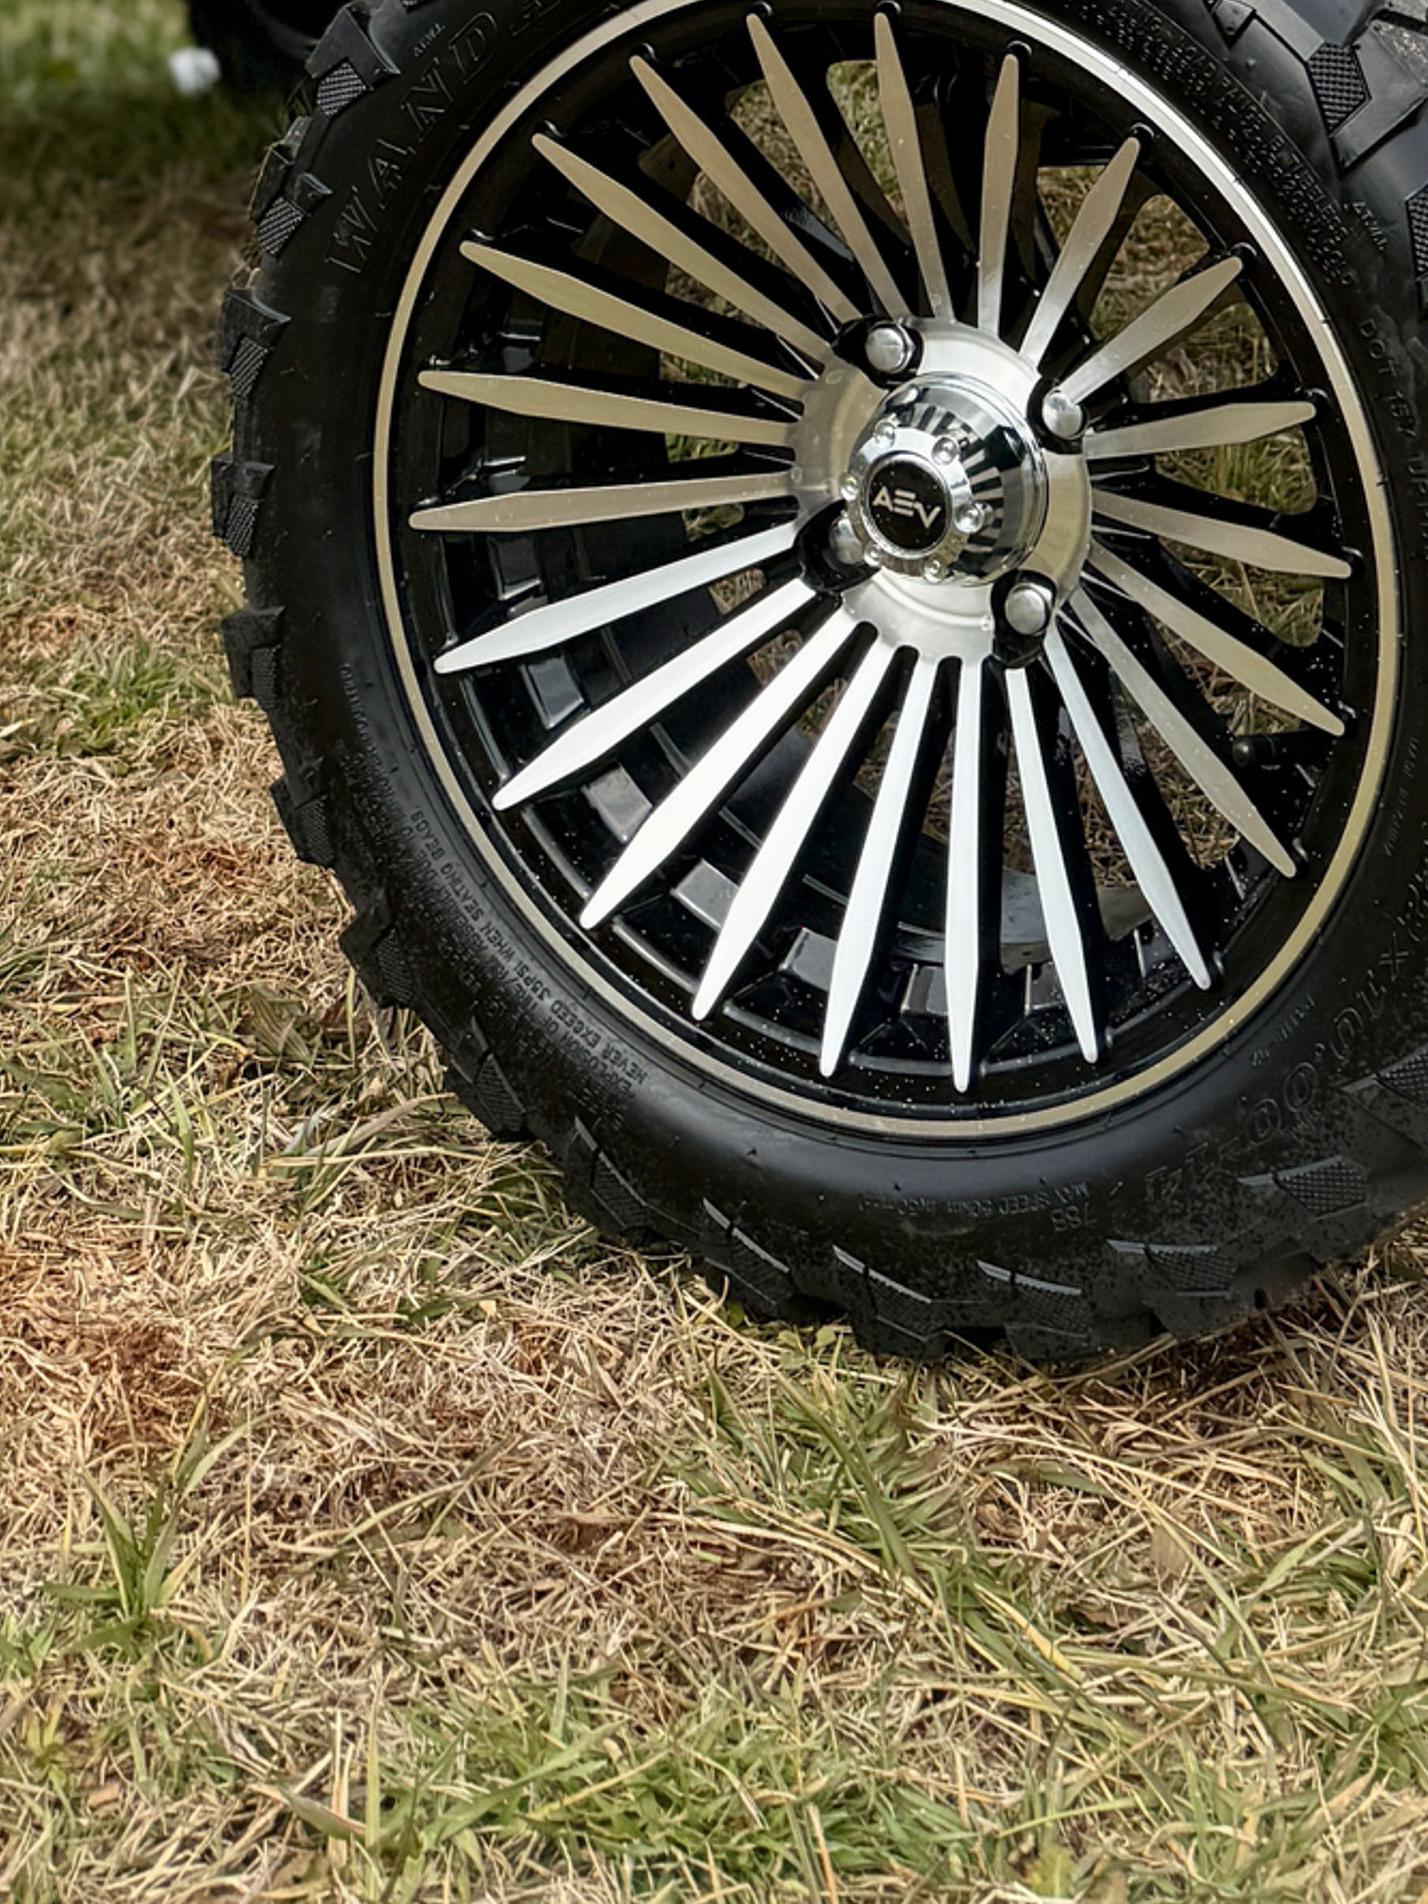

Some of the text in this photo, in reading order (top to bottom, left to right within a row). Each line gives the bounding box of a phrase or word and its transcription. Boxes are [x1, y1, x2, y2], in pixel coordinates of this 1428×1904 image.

[1358, 318, 1397, 377] DOT
[872, 486, 941, 530] AEV
[436, 855, 486, 923] SEATING
[476, 915, 517, 963] WHEN
[547, 995, 603, 1051] EXCEED
[598, 1039, 649, 1085] NEVER
